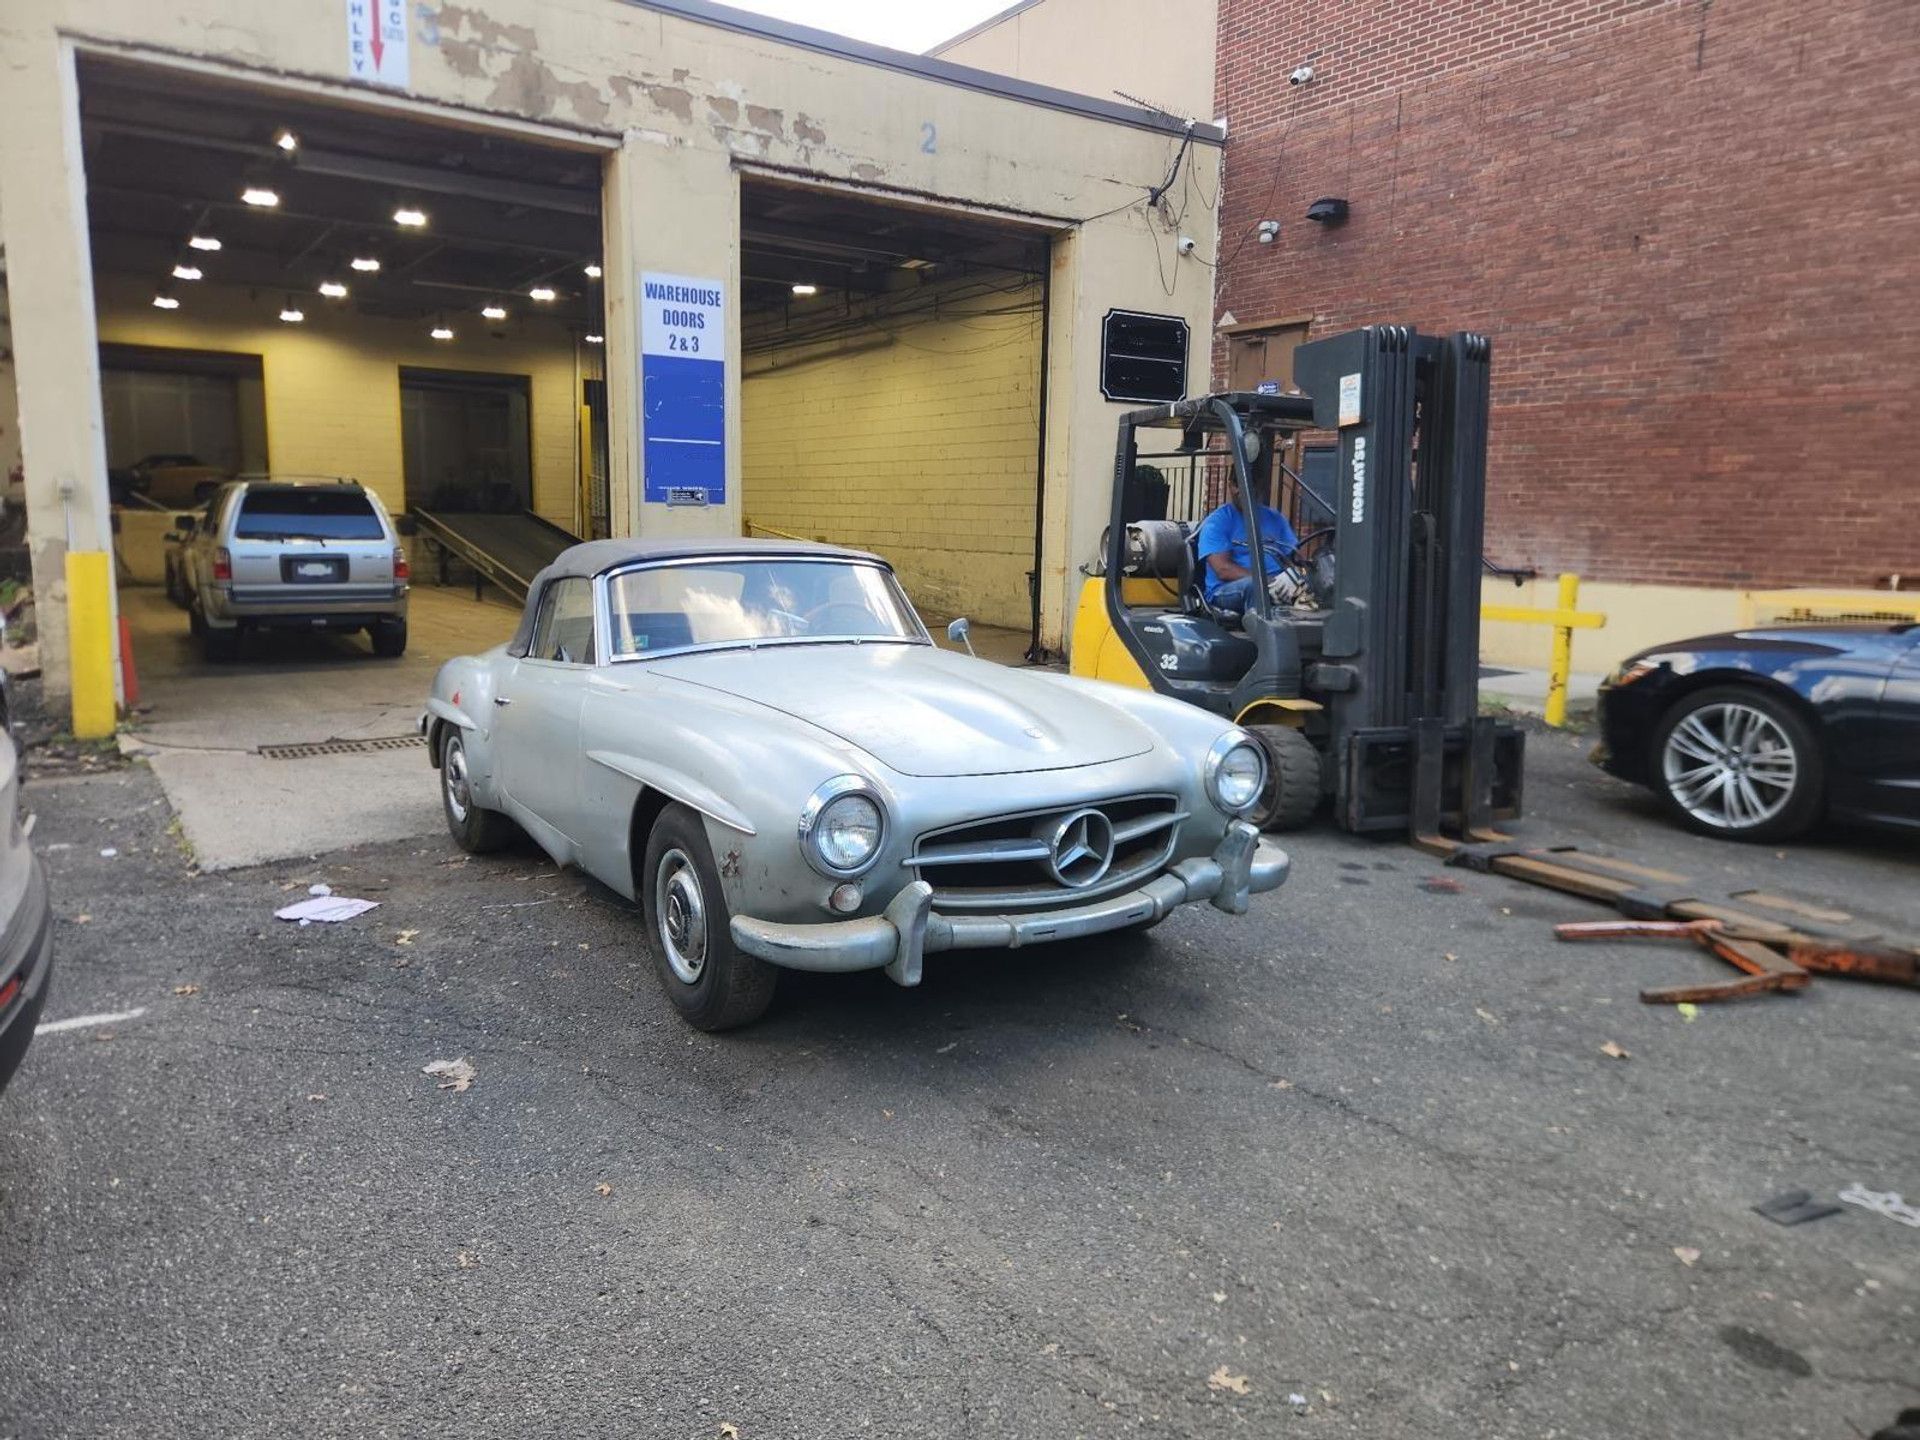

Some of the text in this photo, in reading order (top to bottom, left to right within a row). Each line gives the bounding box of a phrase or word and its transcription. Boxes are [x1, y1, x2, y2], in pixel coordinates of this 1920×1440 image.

[415, 4, 441, 46] 3
[920, 122, 937, 155] 2
[645, 282, 721, 307] WAREHOUSE
[662, 308, 705, 329] DOORS
[669, 334, 699, 353] 2 & 3
[1352, 437, 1366, 523] KOMATSU
[1160, 653, 1179, 671] 32
